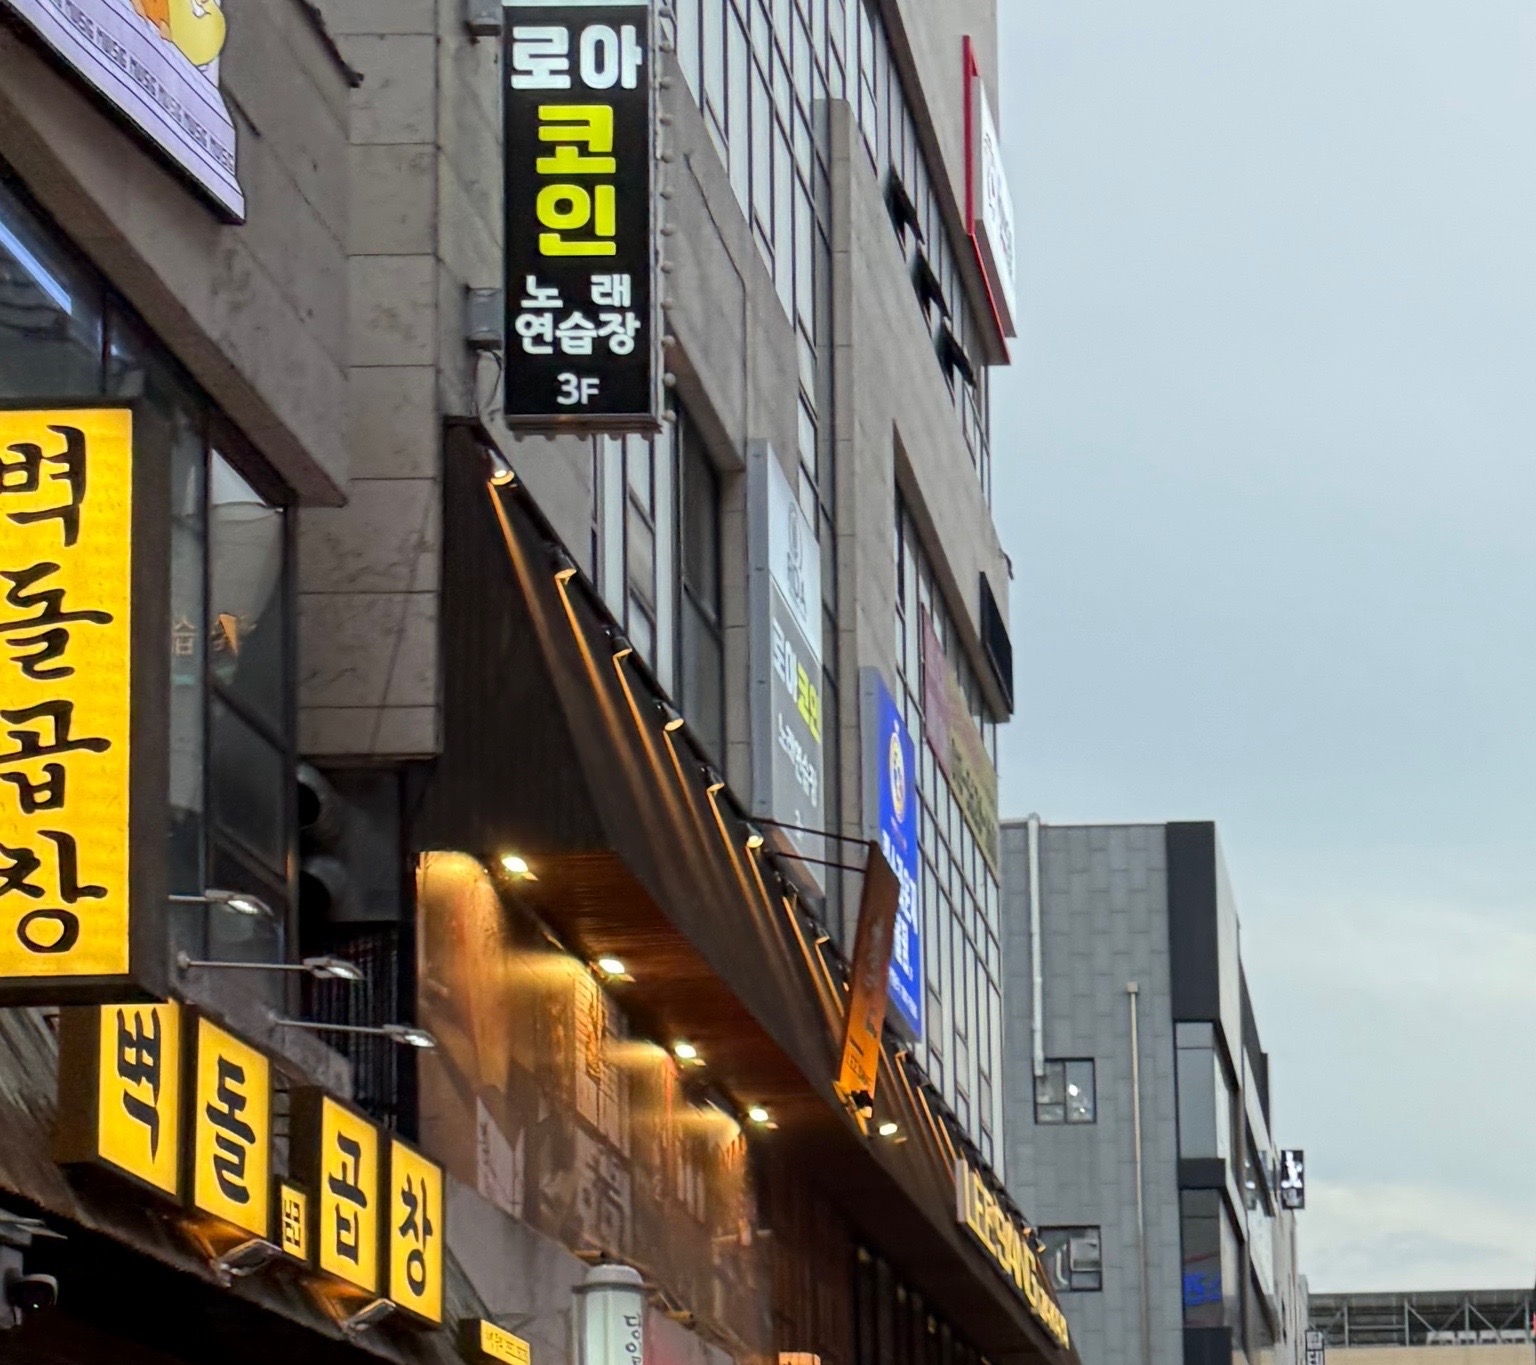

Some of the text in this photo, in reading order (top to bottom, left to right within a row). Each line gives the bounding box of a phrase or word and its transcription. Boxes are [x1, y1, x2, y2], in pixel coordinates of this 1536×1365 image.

[511, 25, 642, 90] 로아
[536, 104, 617, 257] 코인
[515, 314, 641, 355] 연습장
[556, 374, 600, 405] 3F
